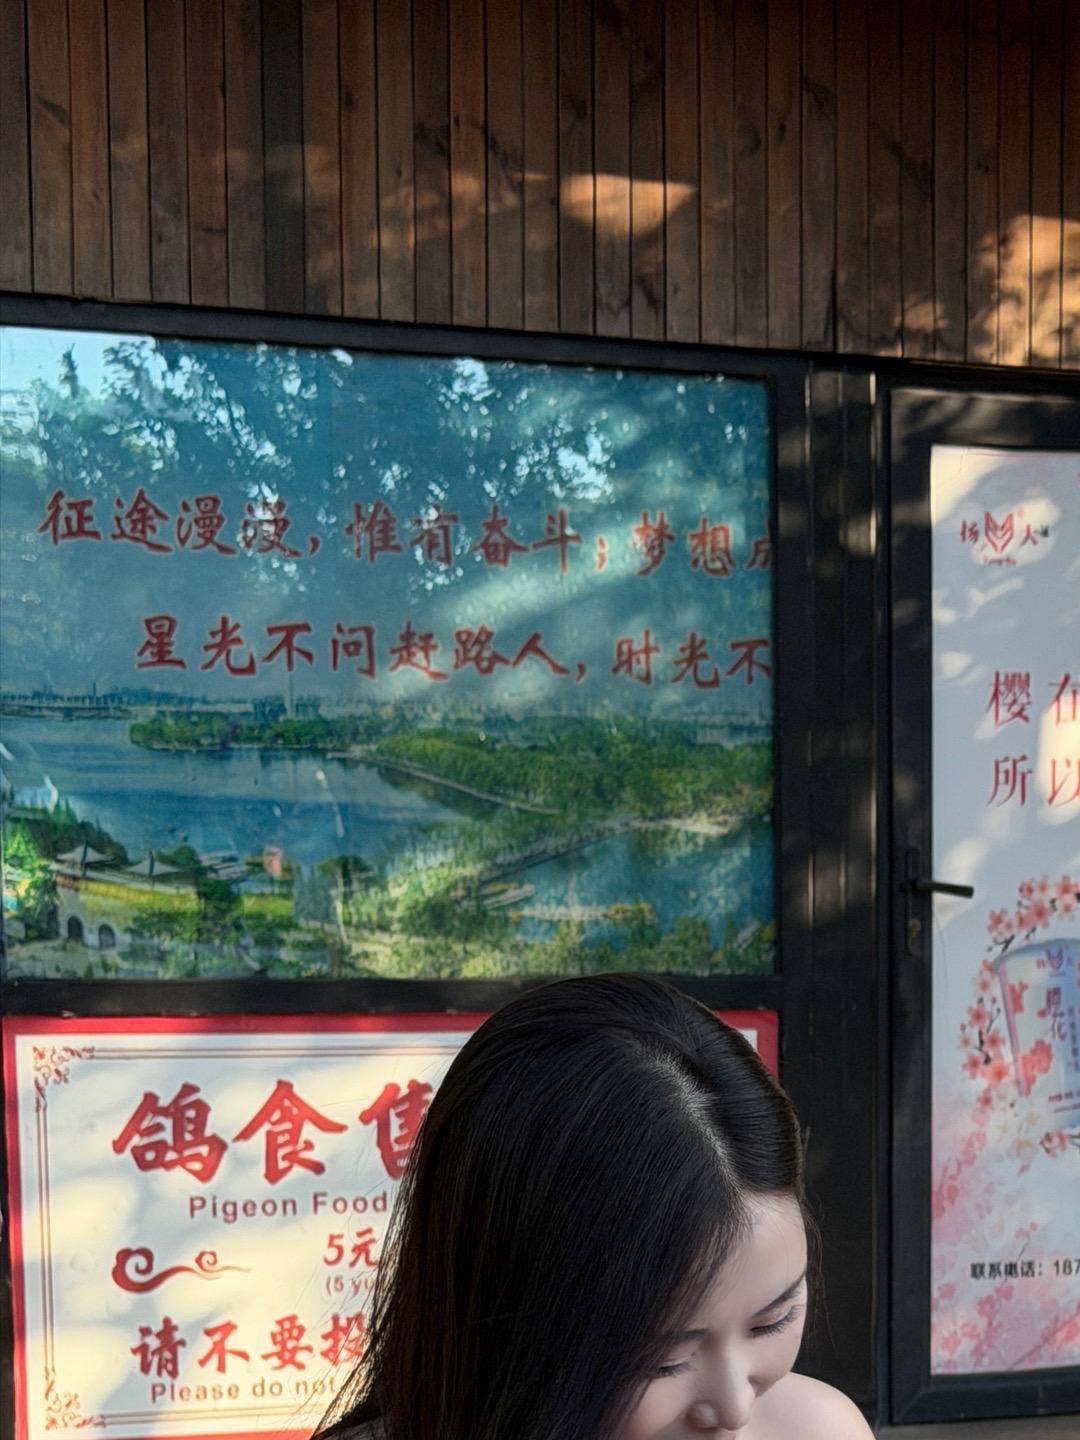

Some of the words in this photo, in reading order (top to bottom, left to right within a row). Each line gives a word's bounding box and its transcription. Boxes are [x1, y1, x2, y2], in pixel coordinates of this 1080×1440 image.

[188, 1195, 298, 1224] Pigeon
[312, 1190, 388, 1216] Food
[323, 1227, 378, 1268] 5元
[150, 1381, 239, 1404] Please
[251, 1378, 283, 1397] do
[295, 1376, 335, 1397] not
